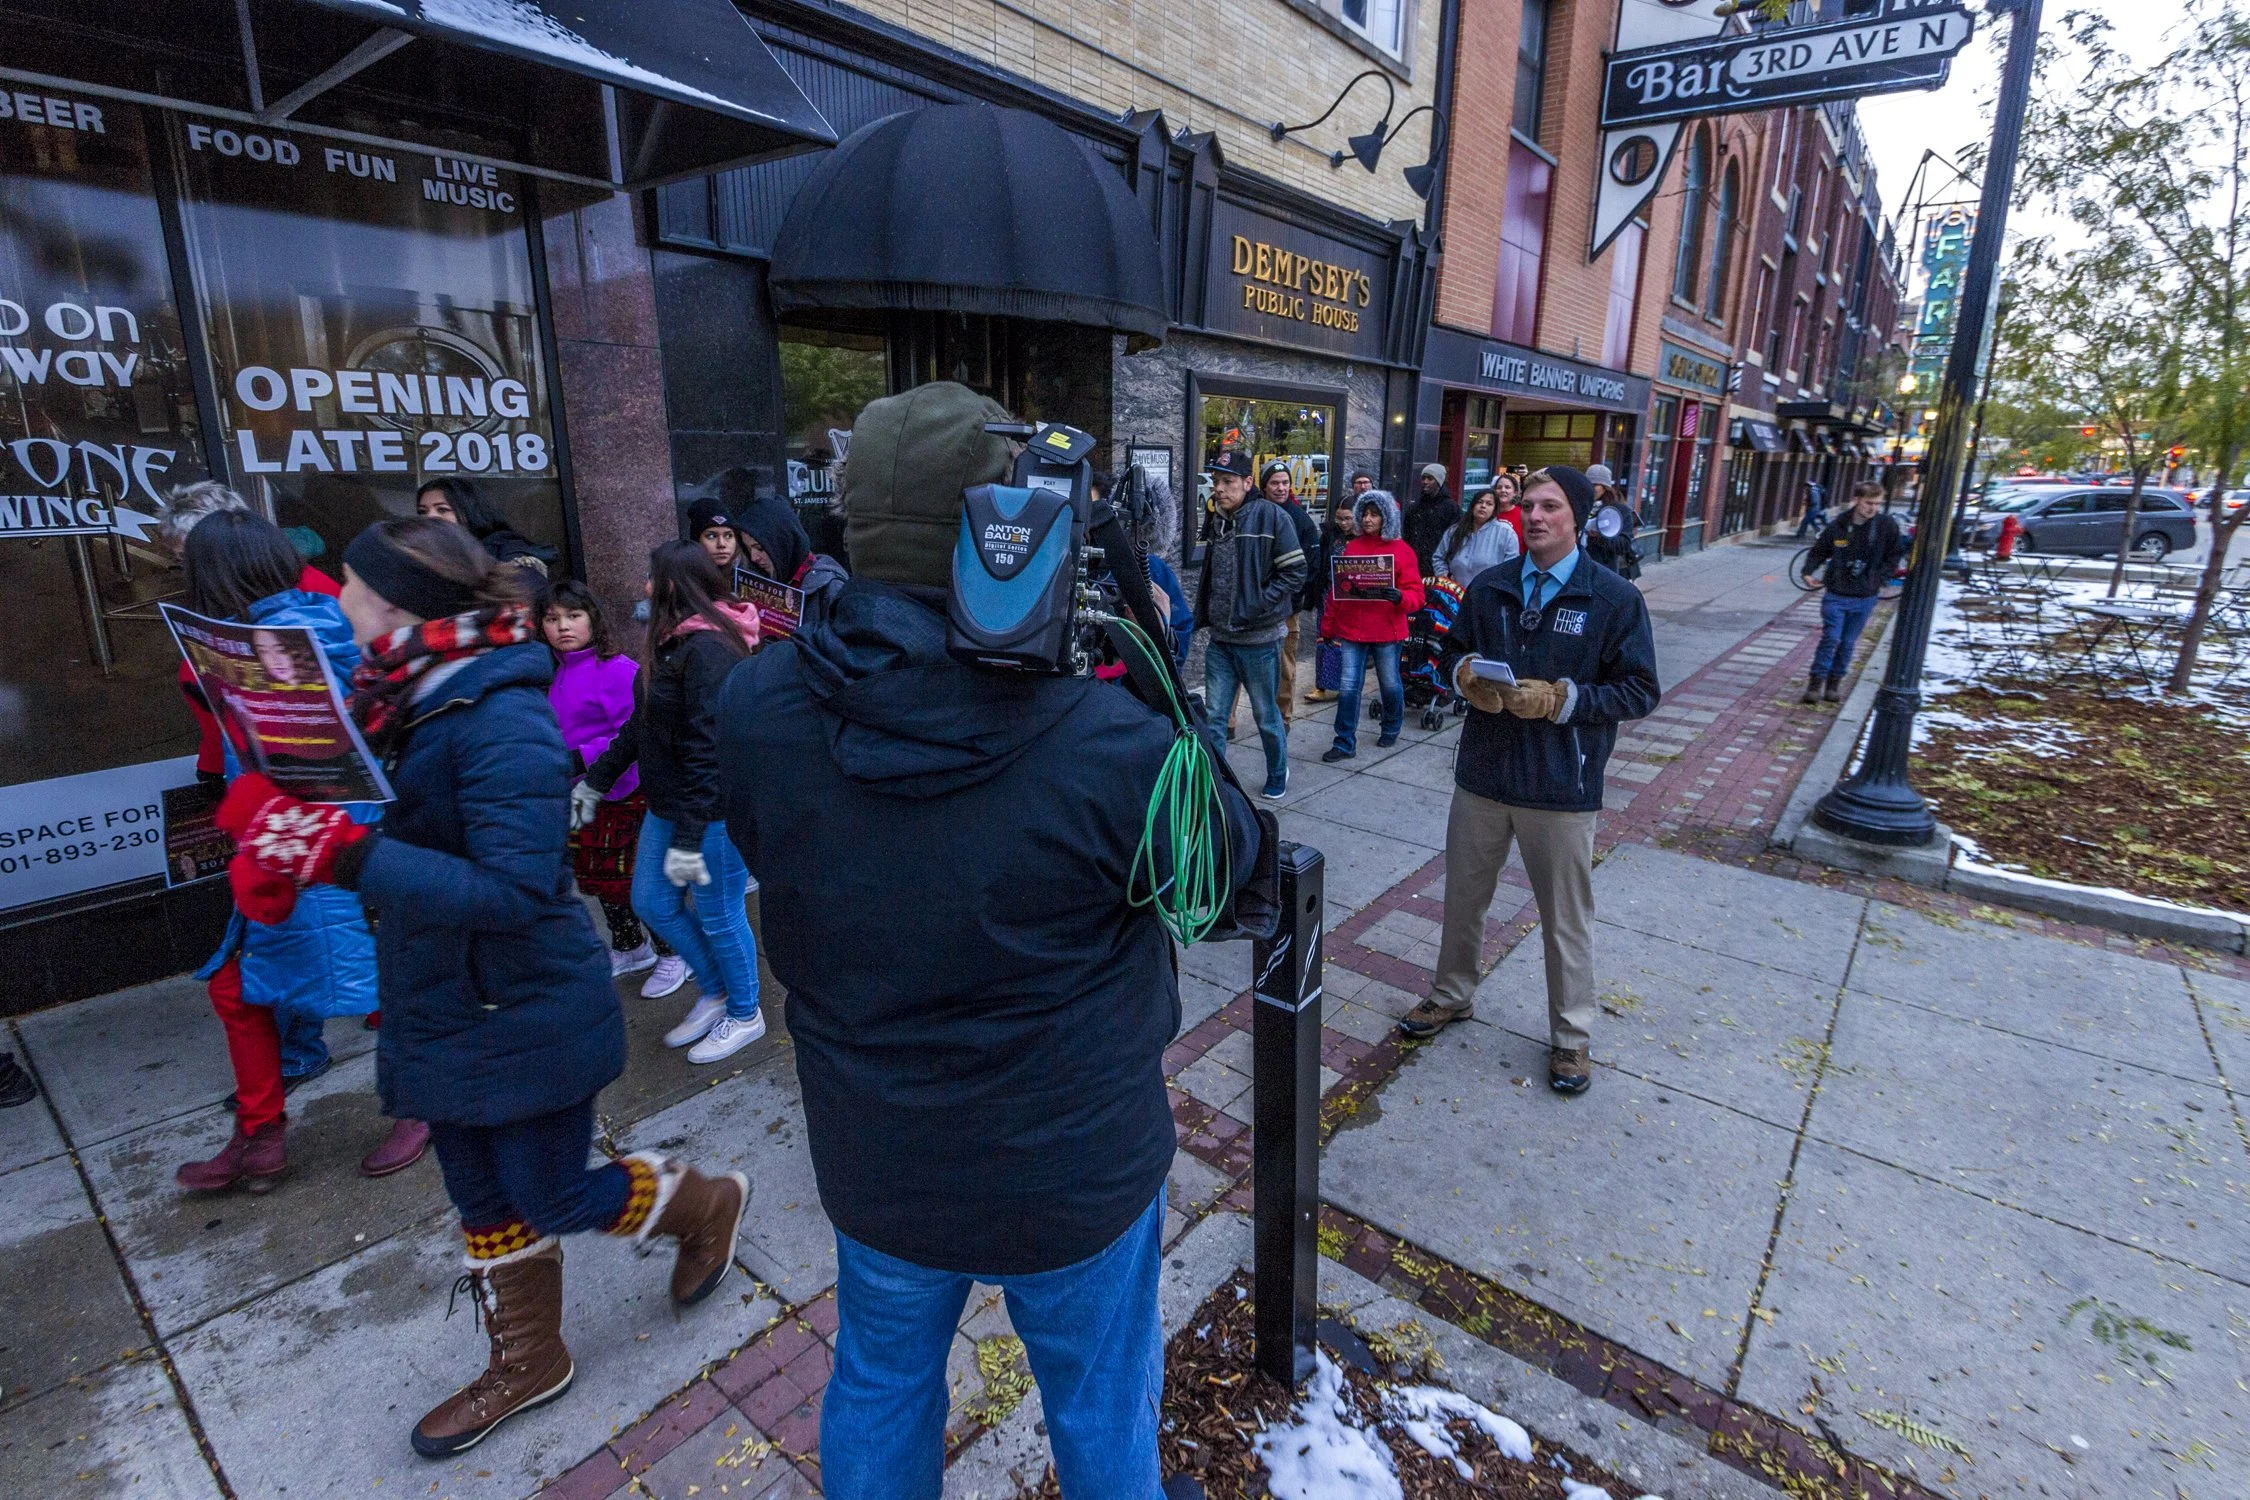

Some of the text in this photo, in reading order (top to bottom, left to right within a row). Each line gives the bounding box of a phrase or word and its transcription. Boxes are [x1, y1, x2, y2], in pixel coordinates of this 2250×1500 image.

[1747, 18, 1948, 78] 3RD AVE N
[0, 89, 105, 134] BEER
[187, 124, 396, 183] FOOD FUN
[434, 157, 499, 187] LIVE
[422, 179, 516, 213] MUSIC
[1233, 235, 1371, 308] DEMPSEY'S
[45, 302, 140, 343] on
[1244, 284, 1359, 333] PUBLIC HOUSE
[0, 347, 138, 387] way
[1481, 352, 1625, 401] WHITE BANNER UNIFORMS
[235, 365, 530, 419] OPENING
[0, 438, 177, 508] ONE
[236, 429, 549, 473] LATE 2018
[792, 463, 836, 493] GUI
[984, 532, 1030, 543] BAUER
[986, 524, 1031, 536] ANTON
[995, 552, 1014, 565] 150
[737, 575, 783, 597] MARCH FOR
[0, 816, 95, 848] SPACE
[104, 804, 161, 828] FOR
[0, 828, 160, 873] 01-893-230
